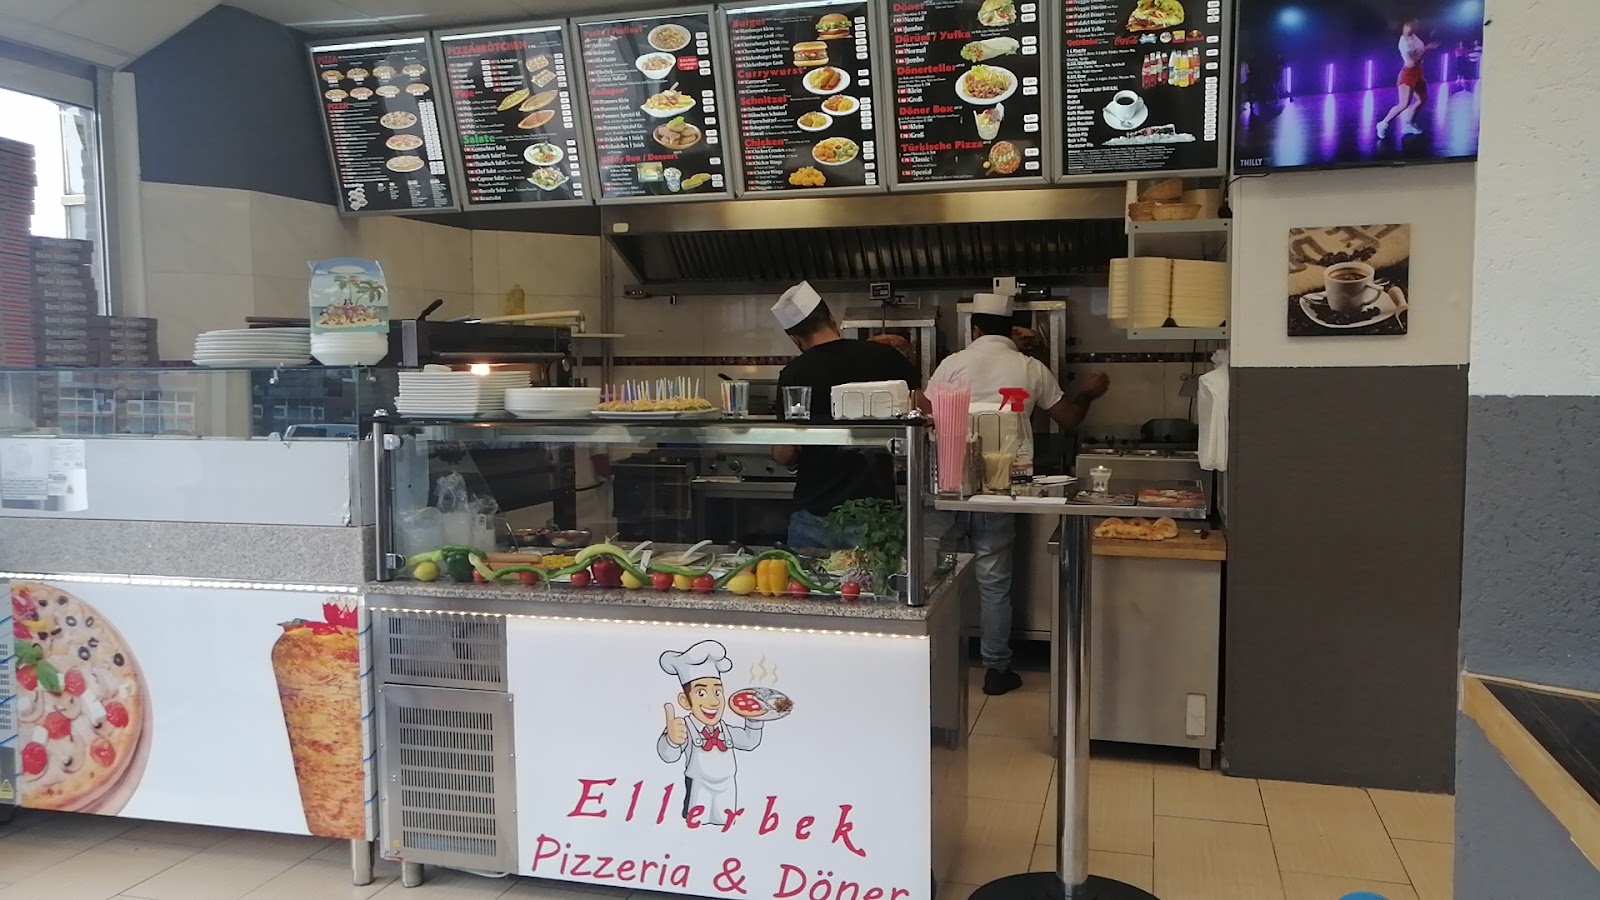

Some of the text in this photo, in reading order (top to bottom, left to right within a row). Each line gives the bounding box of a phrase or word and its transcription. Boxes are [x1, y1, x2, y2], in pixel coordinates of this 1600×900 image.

[893, 3, 924, 11] Döner
[895, 33, 931, 43] Dürüm
[940, 30, 971, 40] Yufka
[736, 67, 804, 78] Currywurst
[896, 63, 956, 75] Dönerteller
[740, 95, 787, 105] Schnitzel
[899, 106, 930, 115] Döner
[463, 134, 495, 143] Salate
[744, 138, 784, 147] Chicken
[901, 141, 983, 152] Türkische Pizza
[565, 776, 866, 858] Ellerbek
[531, 833, 910, 900] Pizzeria & Döner
